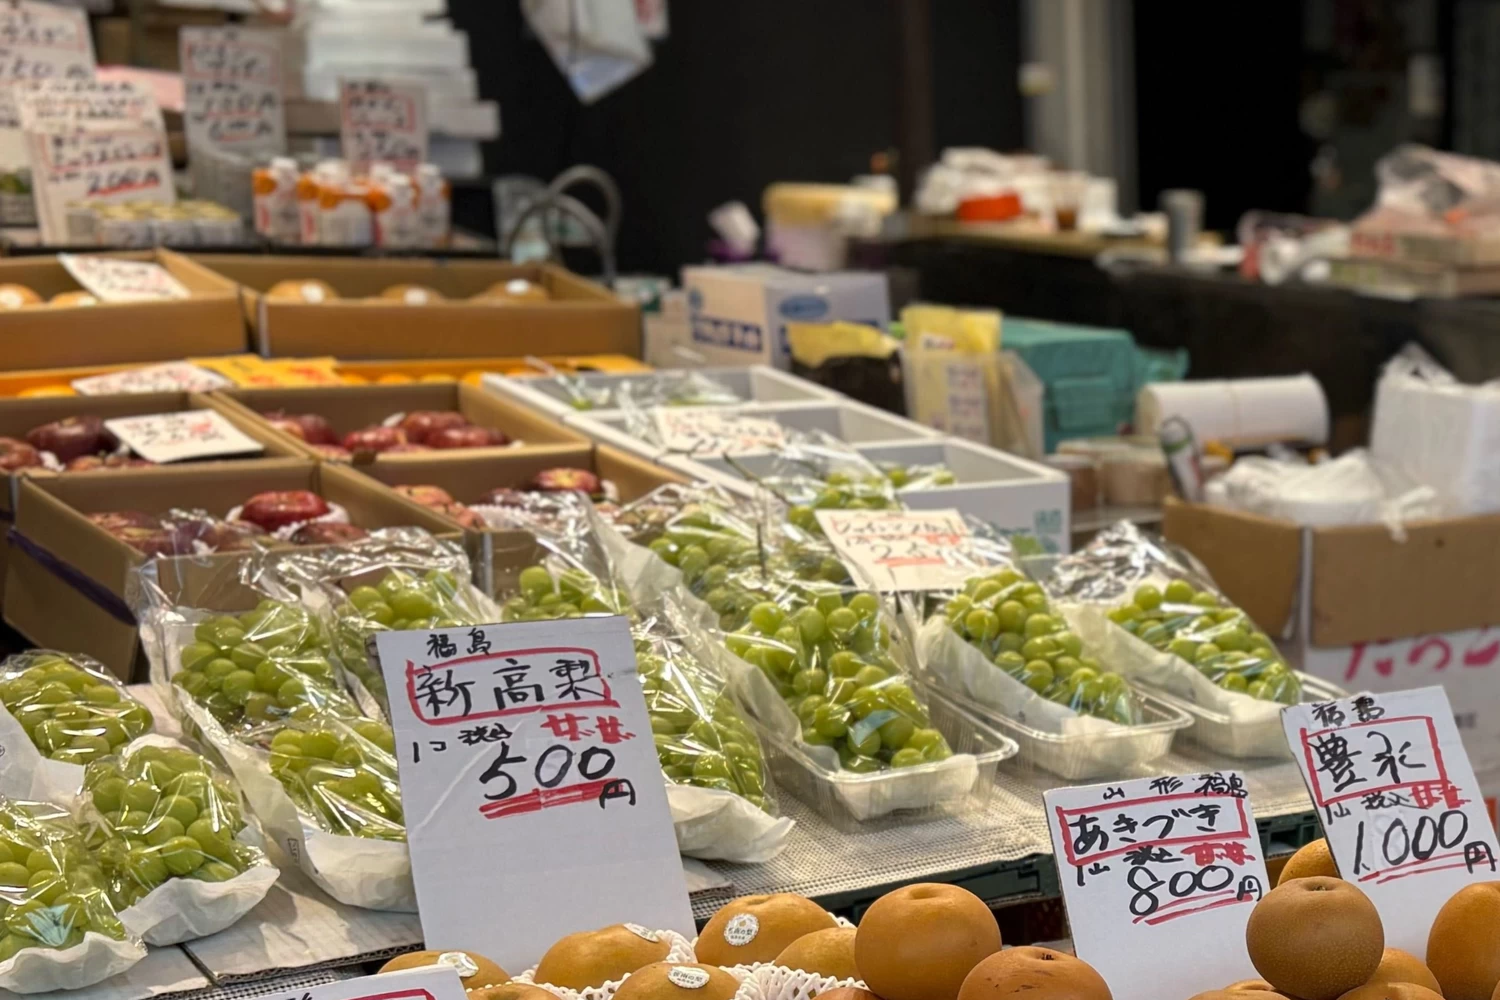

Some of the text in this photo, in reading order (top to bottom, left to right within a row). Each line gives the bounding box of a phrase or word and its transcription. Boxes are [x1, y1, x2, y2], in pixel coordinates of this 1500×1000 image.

[427, 628, 491, 658] 福島
[414, 658, 607, 717] 新高梨
[479, 741, 636, 809] 500円
[1069, 804, 1221, 855] あきづき
[1127, 865, 1262, 916] 800円
